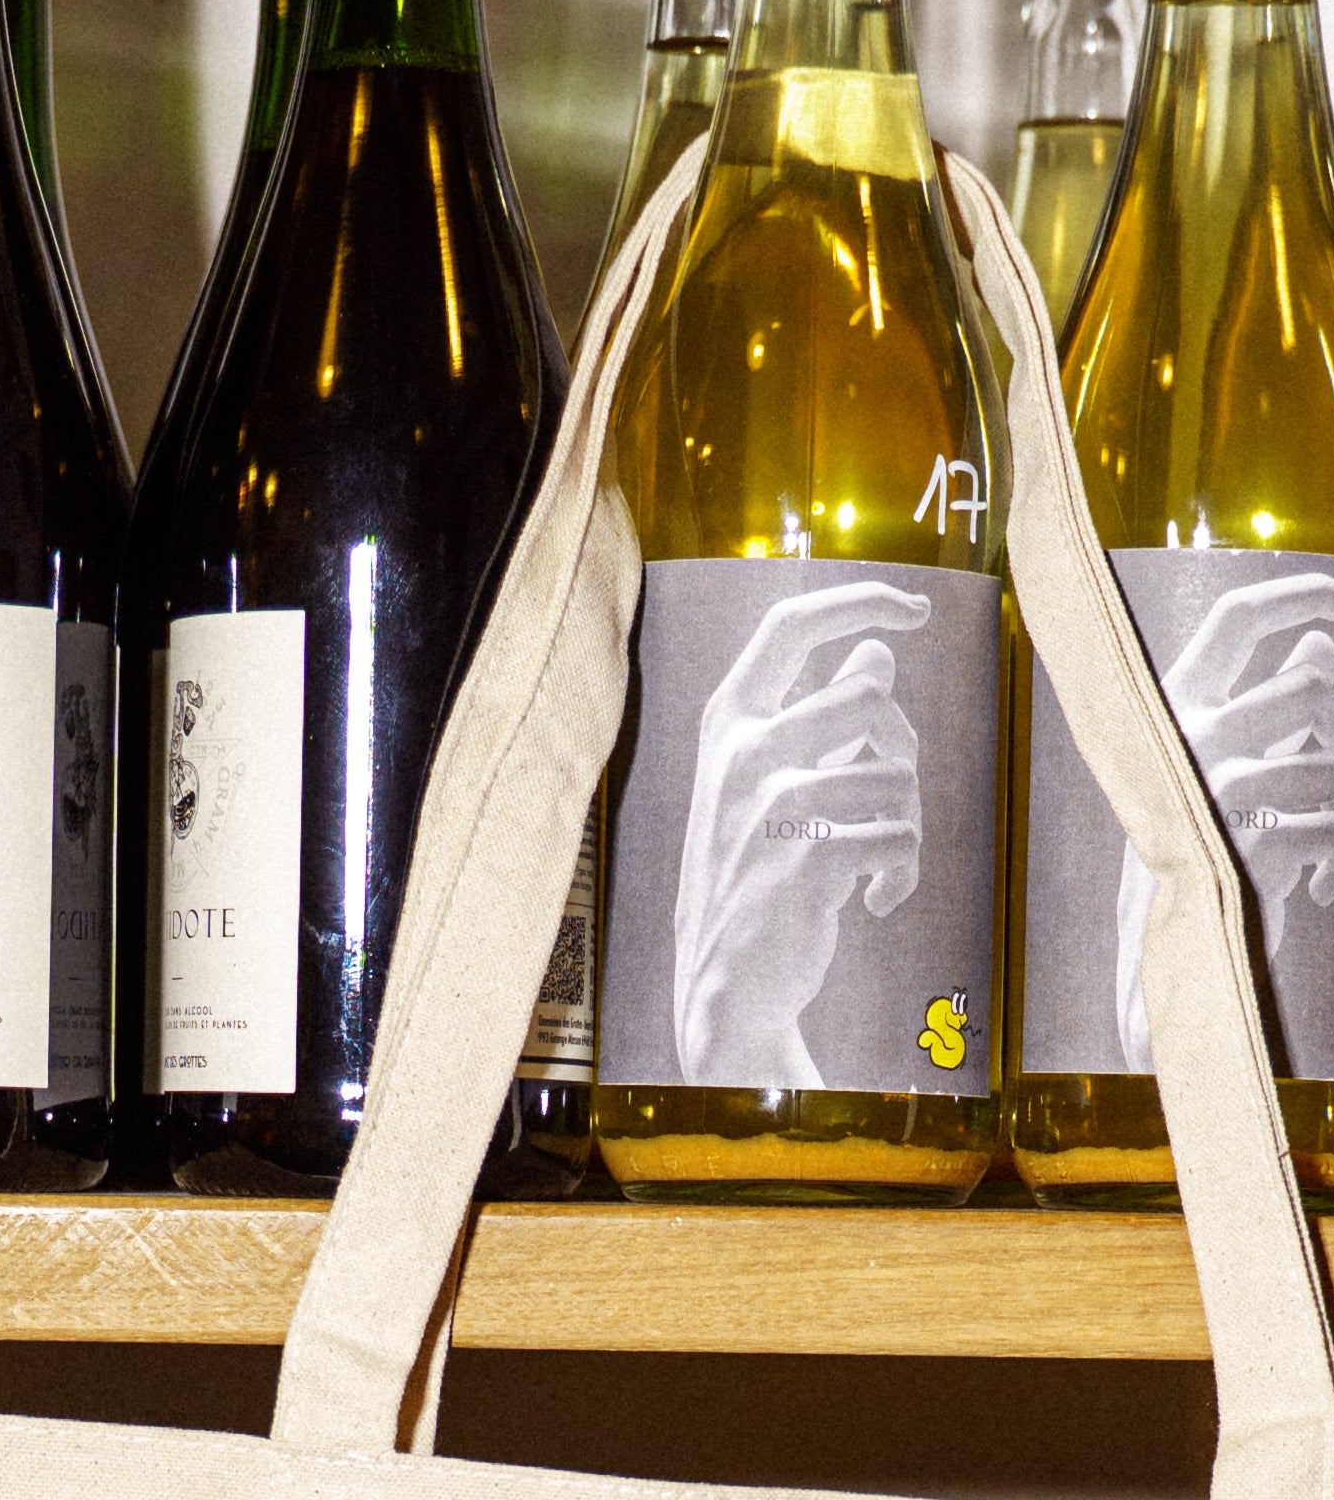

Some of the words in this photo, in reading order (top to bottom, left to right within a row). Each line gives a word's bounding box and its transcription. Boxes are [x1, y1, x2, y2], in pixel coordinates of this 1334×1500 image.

[913, 453, 988, 544] 17
[1225, 808, 1279, 831] ORD
[764, 820, 832, 840] LORD
[184, 1006, 213, 1016] ALCOOL
[201, 1020, 209, 1030] ET
[212, 1020, 248, 1030] PLANTES
